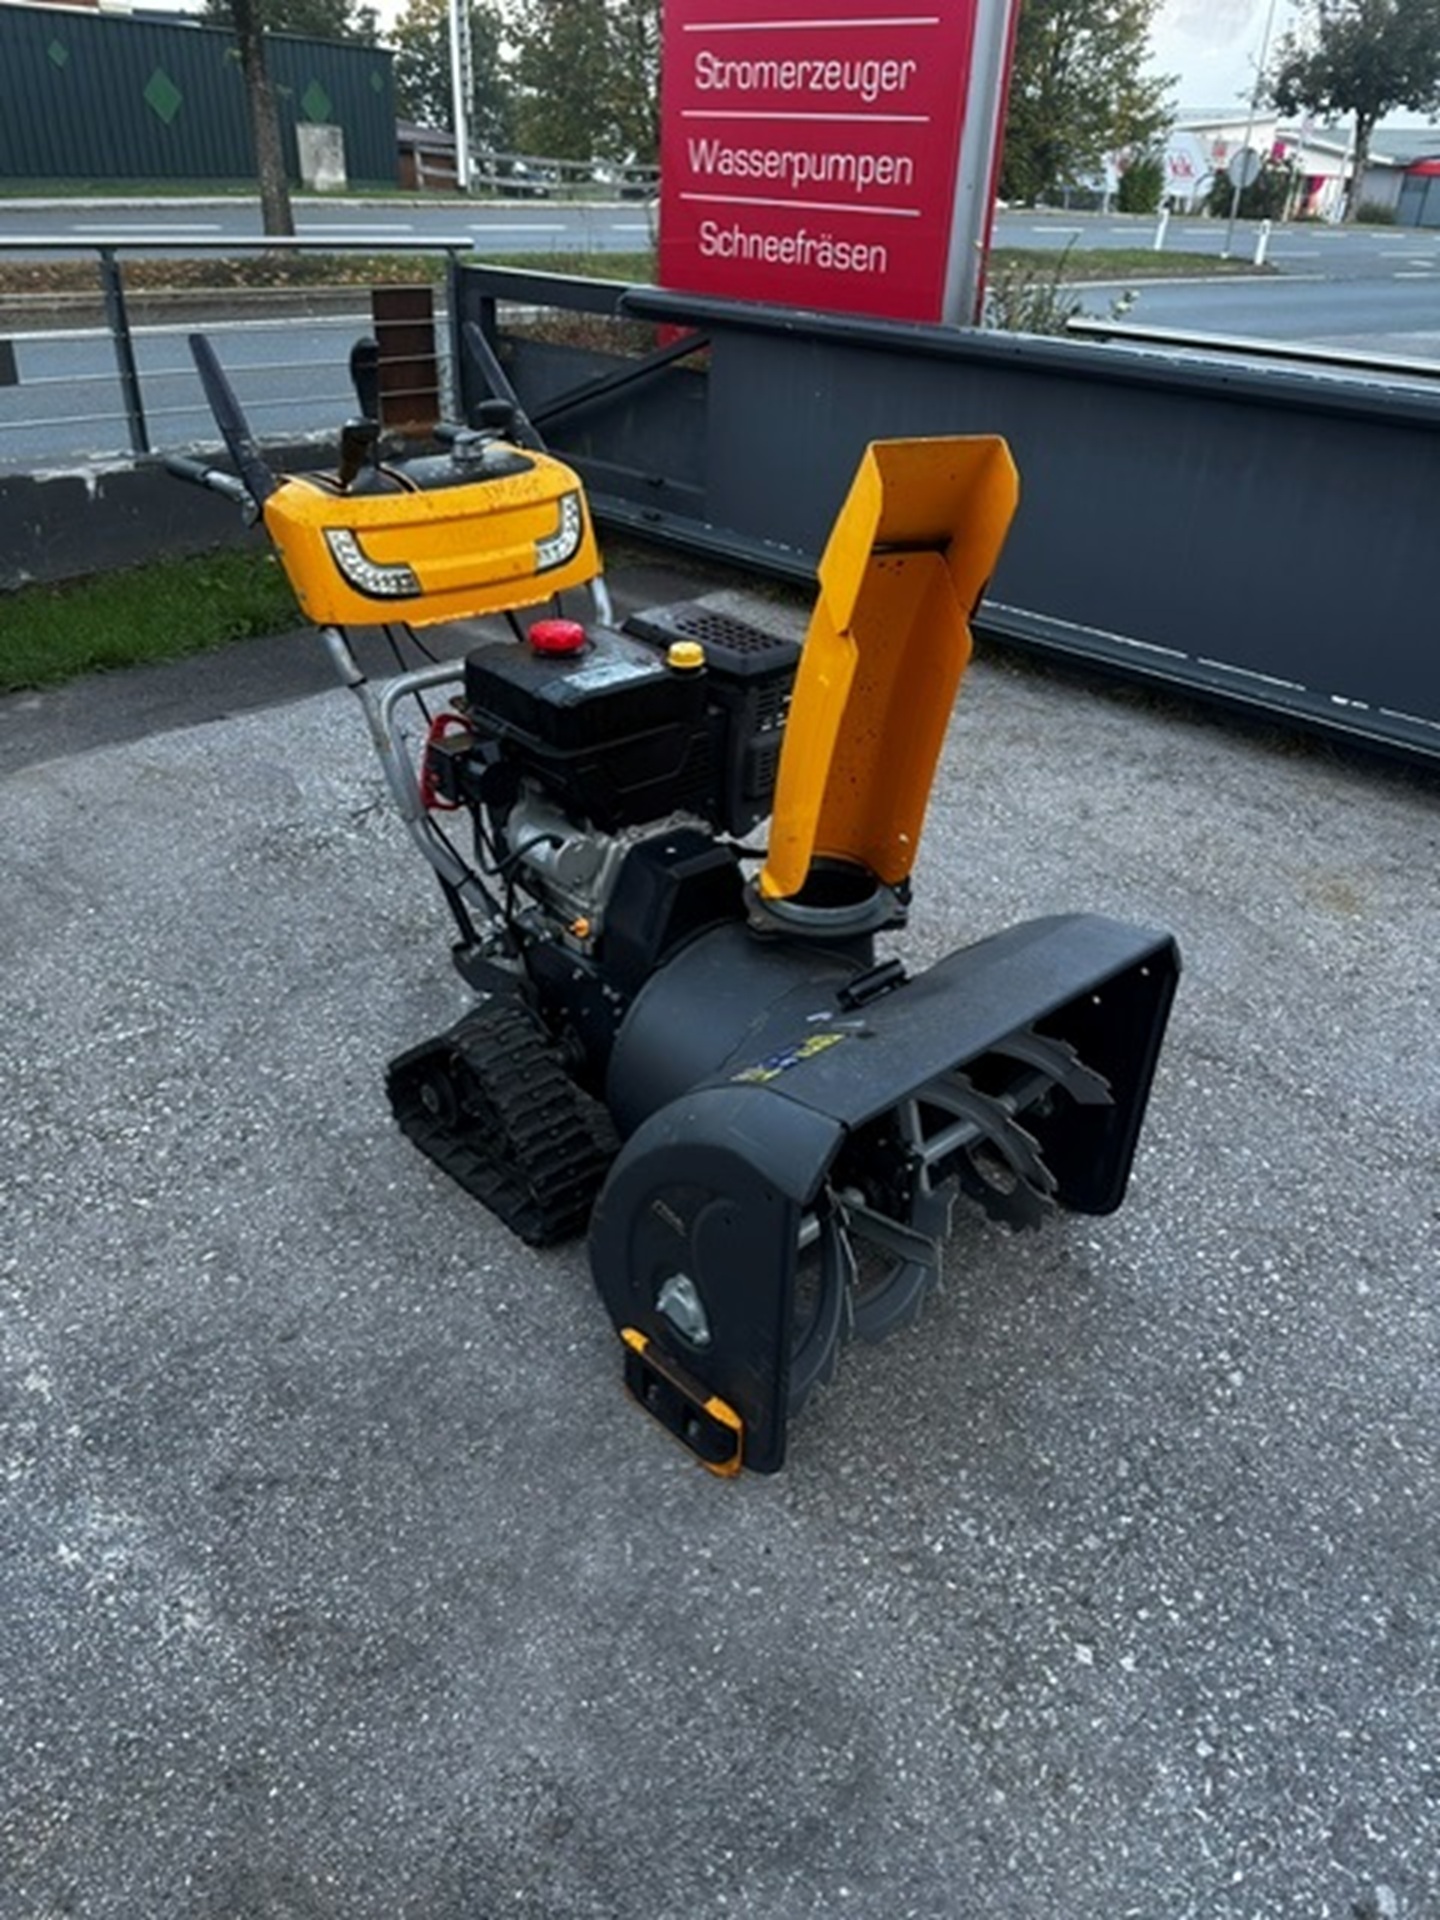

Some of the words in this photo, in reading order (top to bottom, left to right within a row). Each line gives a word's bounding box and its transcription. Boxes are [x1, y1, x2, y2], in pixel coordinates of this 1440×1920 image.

[694, 51, 916, 102] Stromerzeuger
[687, 138, 913, 192] Wasserpumpen
[699, 220, 887, 272] Schneefräsen
